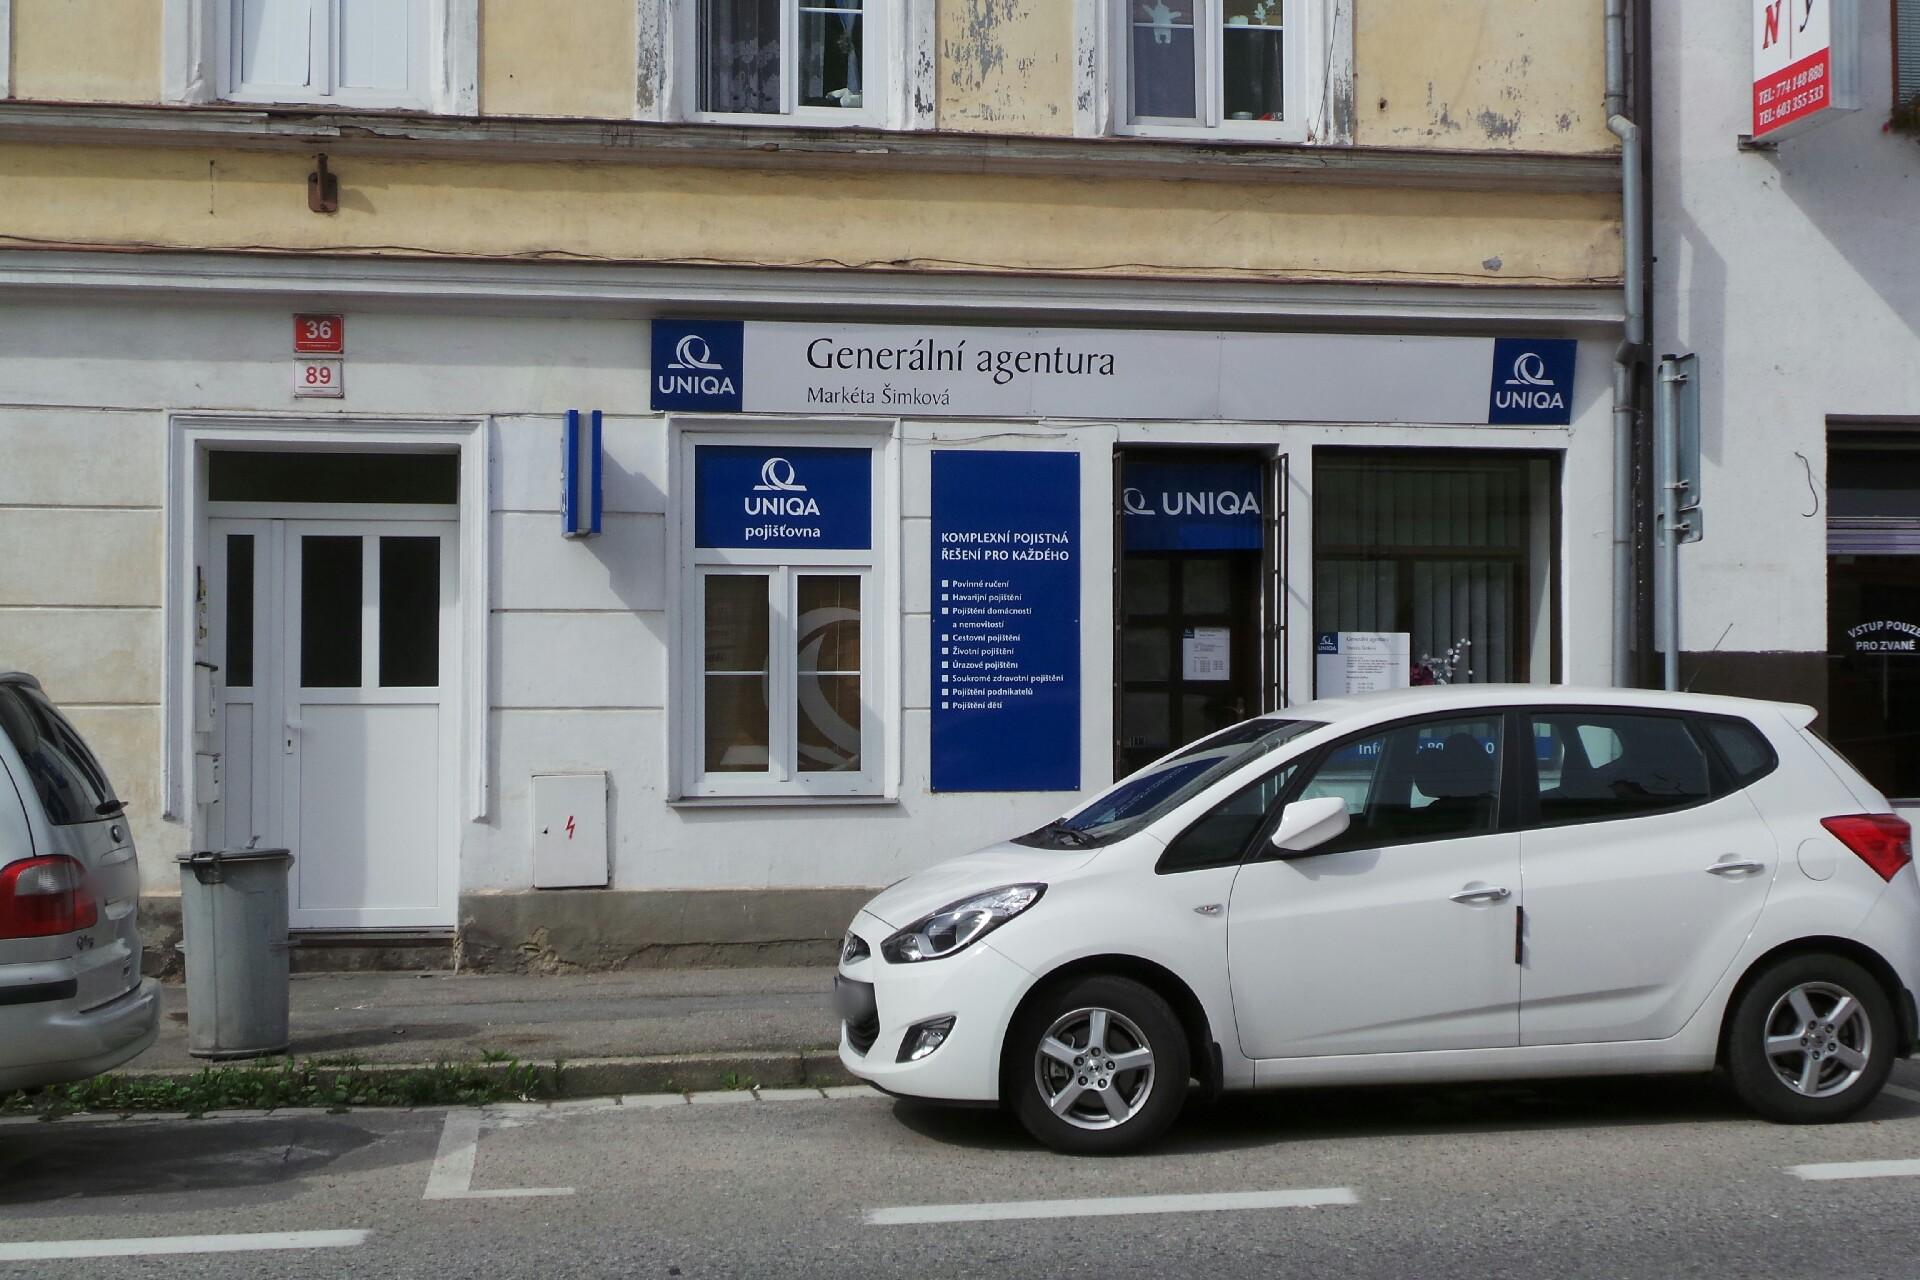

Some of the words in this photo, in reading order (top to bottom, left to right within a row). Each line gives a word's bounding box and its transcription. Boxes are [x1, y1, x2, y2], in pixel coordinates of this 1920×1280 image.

[1776, 79, 1791, 98] 774
[1792, 71, 1808, 90] 148
[1776, 99, 1791, 119] 603
[1791, 92, 1808, 112] 355
[1808, 84, 1824, 104] 533
[305, 320, 332, 339] 36
[806, 337, 967, 372] Generální
[976, 346, 1115, 386] agentura
[305, 366, 332, 385] 89
[658, 375, 736, 395] UNIQA
[806, 386, 875, 404] Markéta
[881, 383, 950, 406] Šimková
[1495, 391, 1564, 409] UNIQA
[744, 497, 821, 516] UNIQA
[1162, 490, 1261, 516] UNIQA
[745, 523, 821, 541] pojišťovna
[941, 530, 1010, 544] KOMPLEXNÍ
[1014, 531, 1069, 545] POJISTNÁ
[941, 547, 981, 560] ŘEŠENÍ
[985, 550, 1009, 561] PRO
[1012, 547, 1070, 561] KAŽDÉHO
[952, 580, 984, 588] Povinné
[985, 580, 1009, 588] ručení
[952, 593, 987, 603] Havarijní
[988, 593, 1022, 603] pojištění
[952, 607, 986, 616] Pojištění
[1848, 621, 1884, 638] VSTUP
[952, 634, 986, 642] Cestovní
[987, 633, 1021, 643] pojištění
[1856, 641, 1878, 651] PRO
[1880, 639, 1916, 651] ZVANÉ
[952, 646, 980, 655] Životní
[981, 647, 1015, 657] pojištění
[952, 659, 984, 669] Úrazové
[985, 661, 1018, 671] pojištění
[952, 674, 991, 682] Soukromé
[992, 674, 1029, 682] zdravotní
[1030, 674, 1064, 684] pojištění
[952, 688, 986, 698] Pojištění
[987, 688, 1033, 698] podnikatelů
[952, 701, 986, 711] Pojištění
